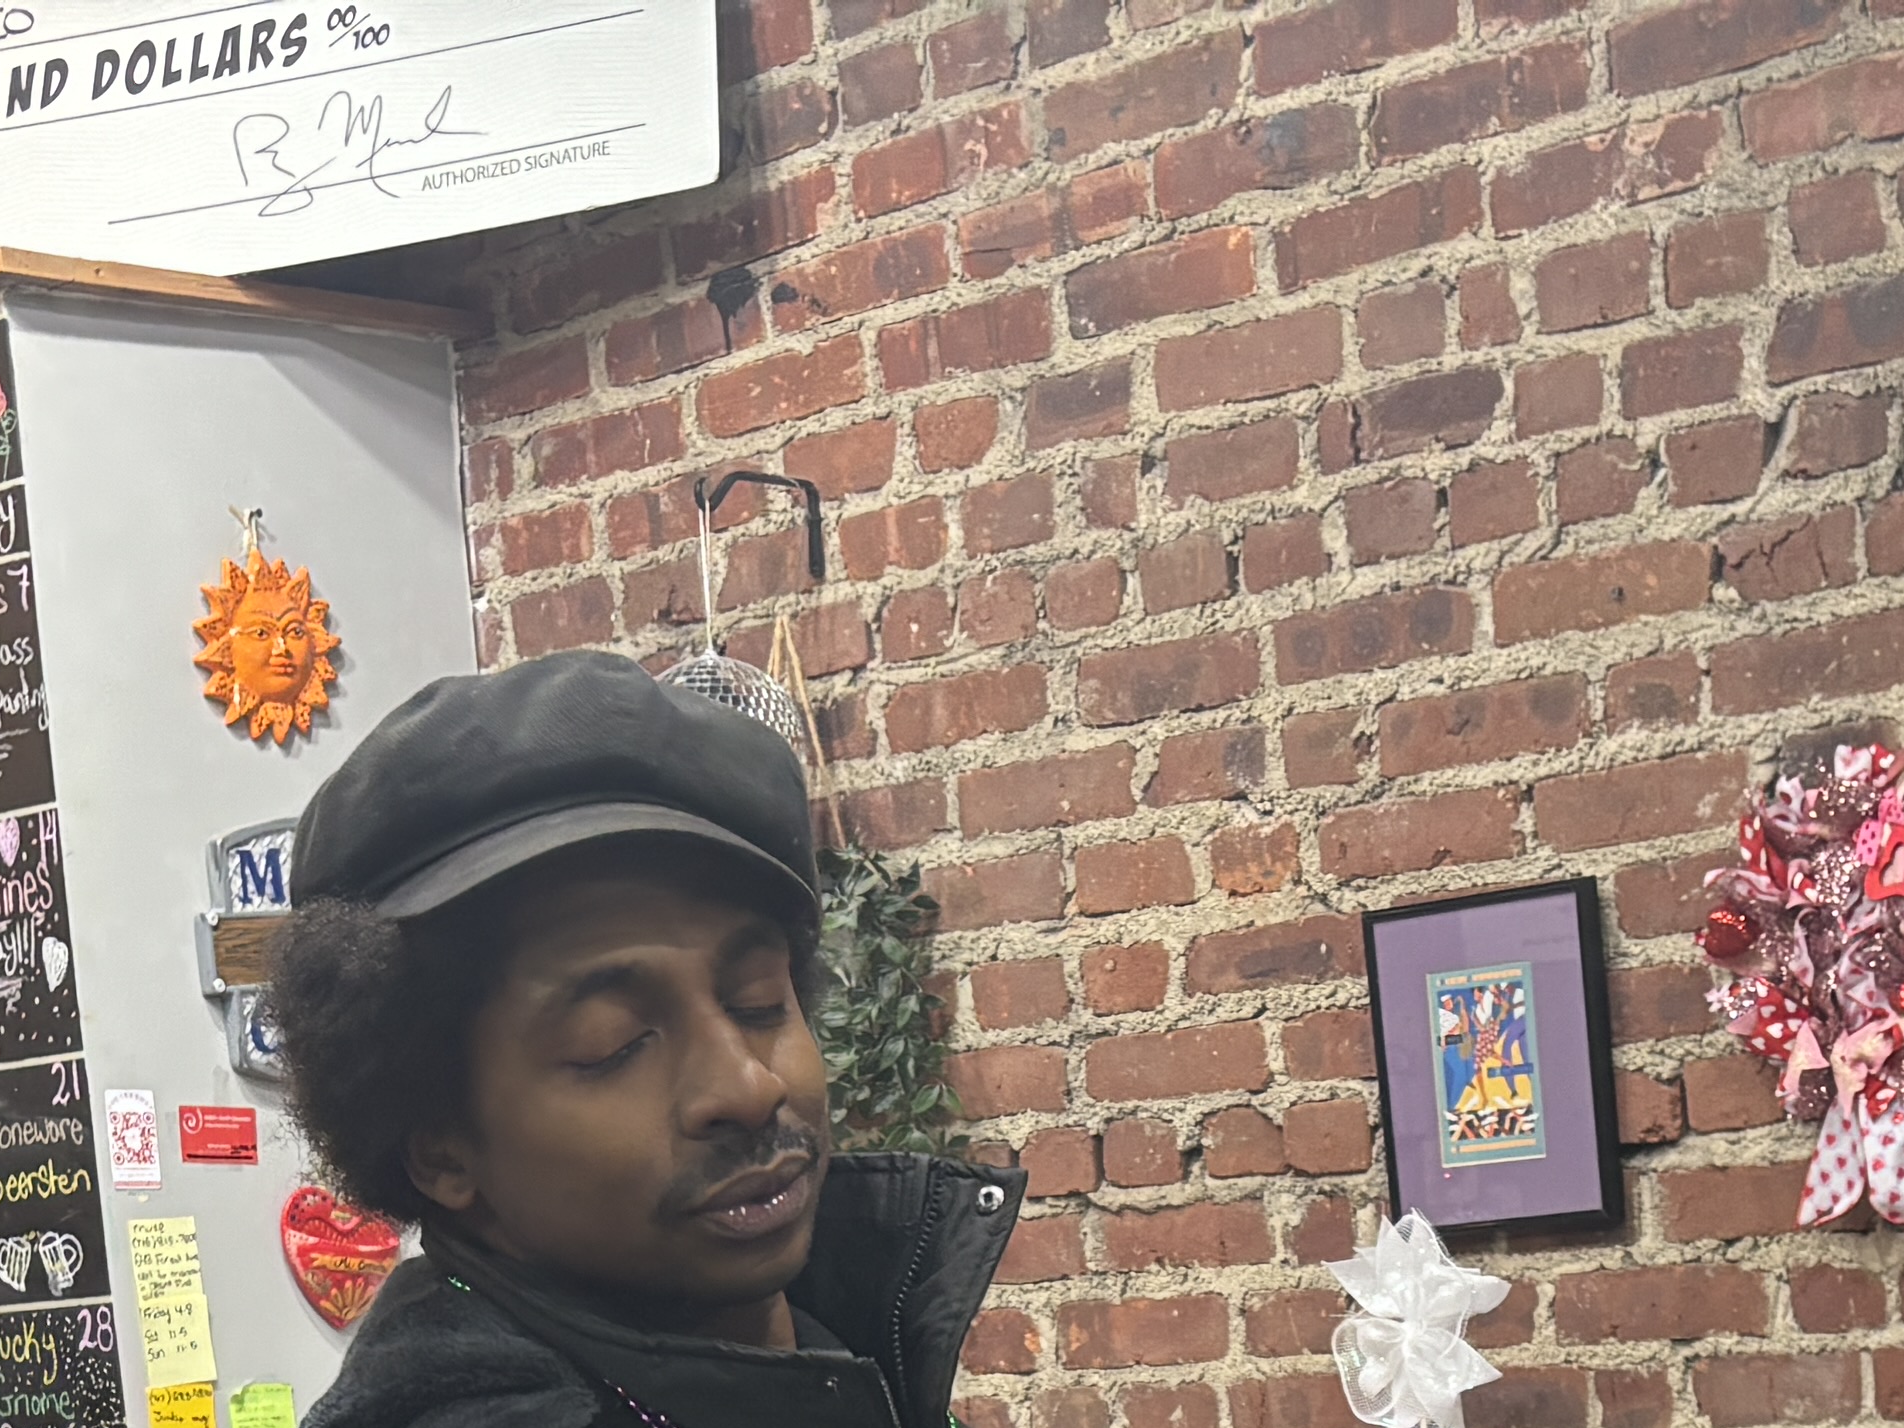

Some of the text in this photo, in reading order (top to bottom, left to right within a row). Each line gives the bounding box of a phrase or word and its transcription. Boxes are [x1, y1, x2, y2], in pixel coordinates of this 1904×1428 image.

[91, 12, 309, 101] DOLLARS
[421, 140, 611, 193] AUTHORIZED SIGNATURE
[7, 564, 31, 611] 7
[39, 810, 59, 865] 14
[50, 1059, 82, 1106] 21
[77, 1306, 114, 1352] 28
